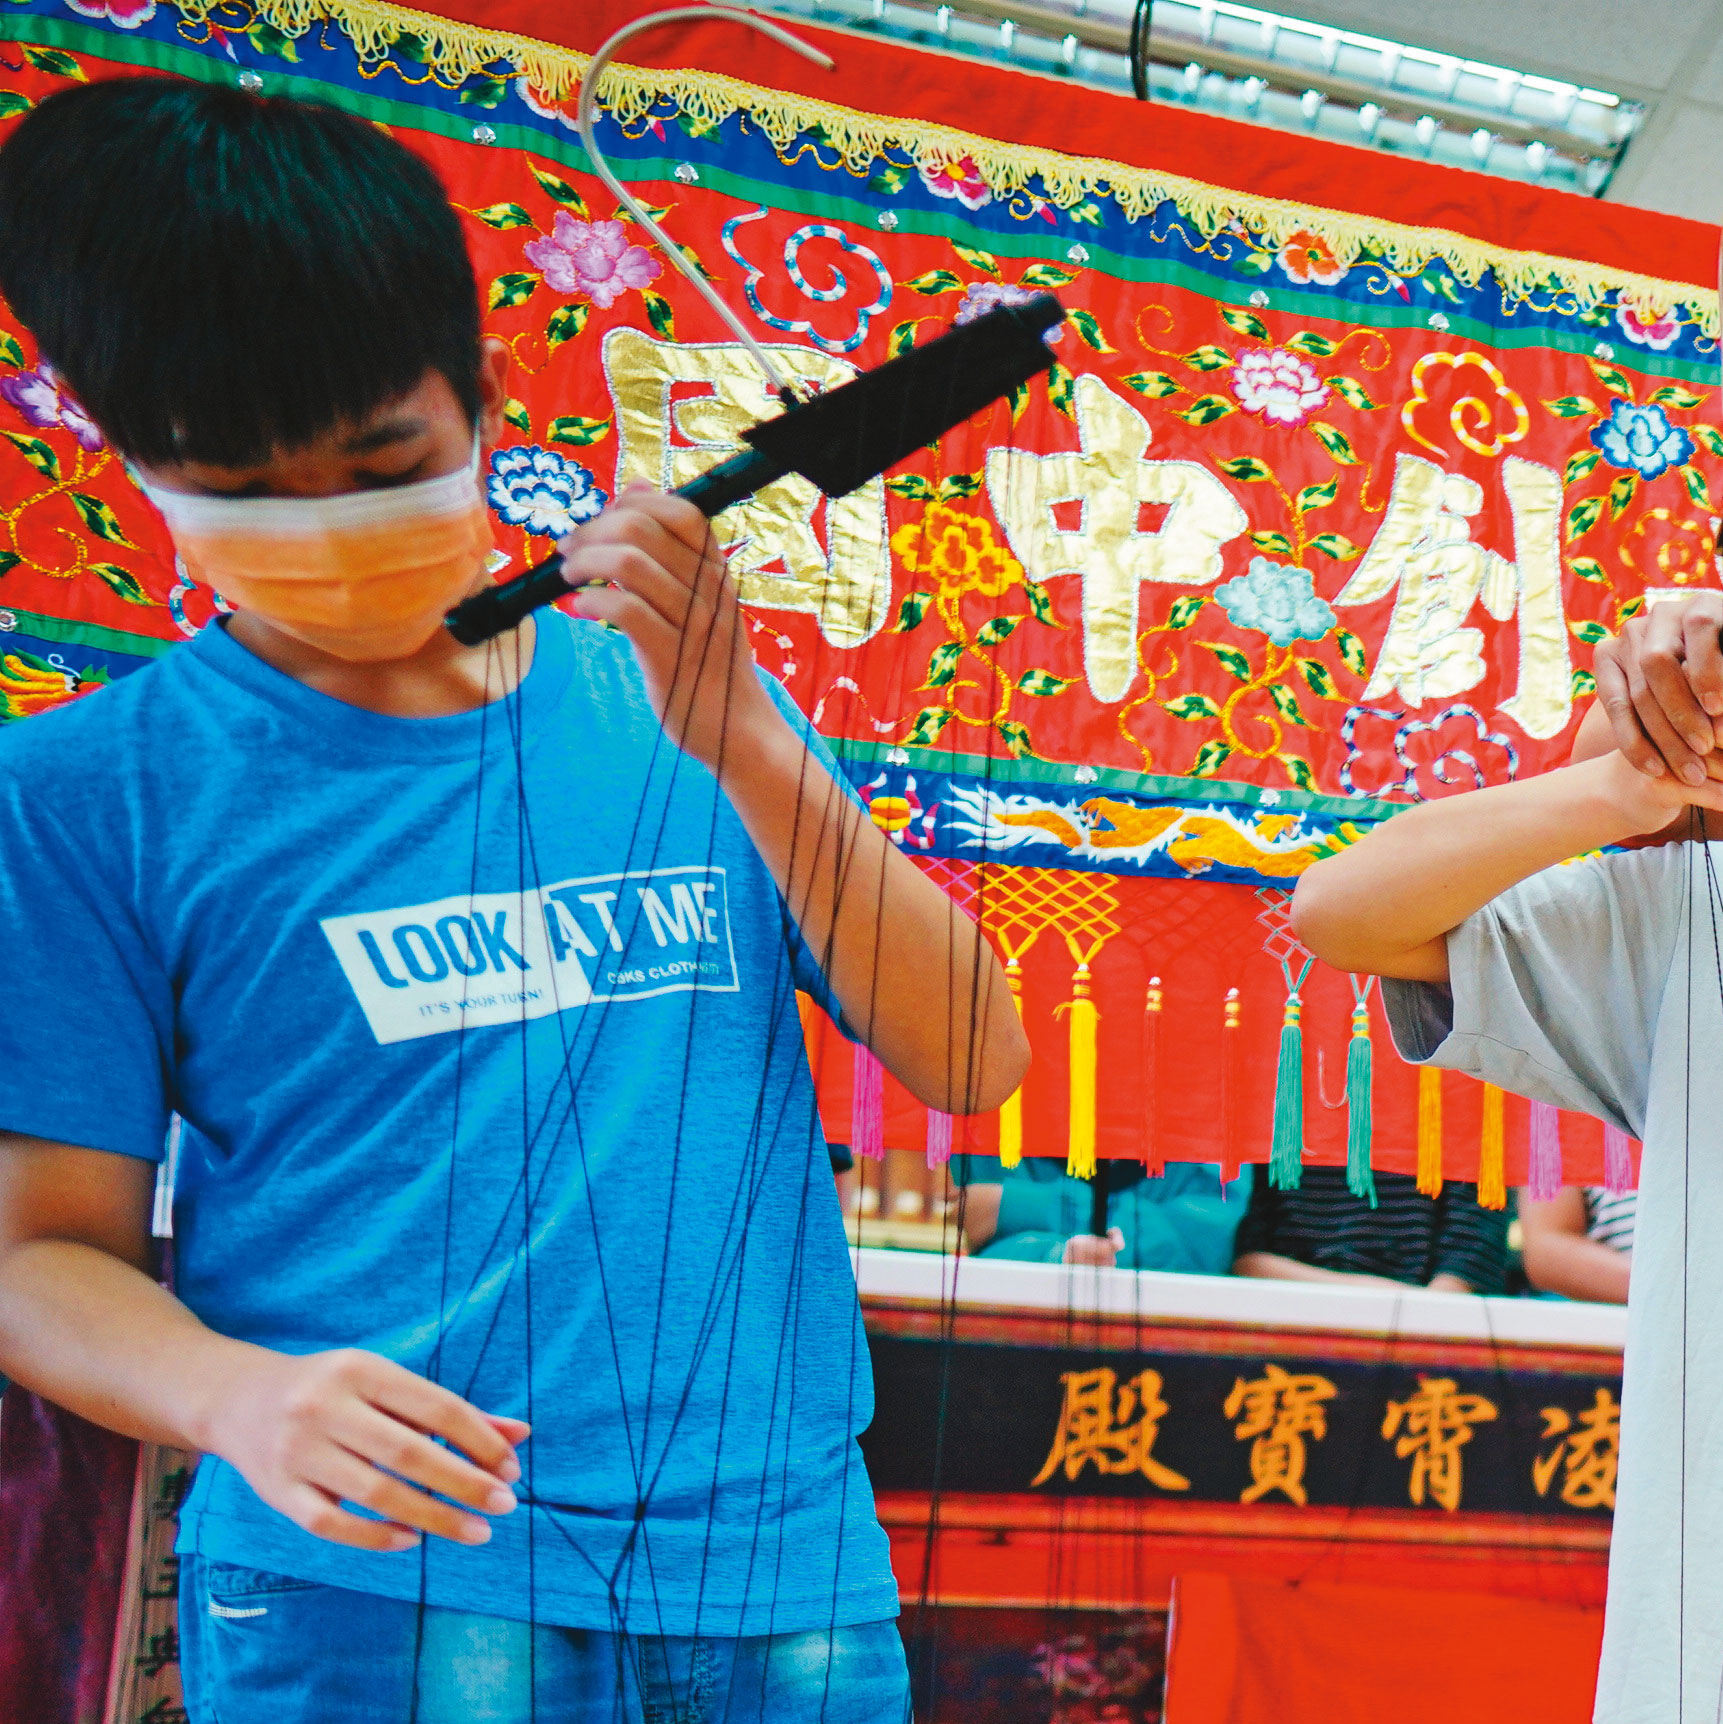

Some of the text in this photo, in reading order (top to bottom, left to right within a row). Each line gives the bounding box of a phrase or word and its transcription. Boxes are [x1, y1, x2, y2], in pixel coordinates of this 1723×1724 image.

[356, 881, 719, 990] LOOK AT ME
[455, 994, 498, 1009] YOUR
